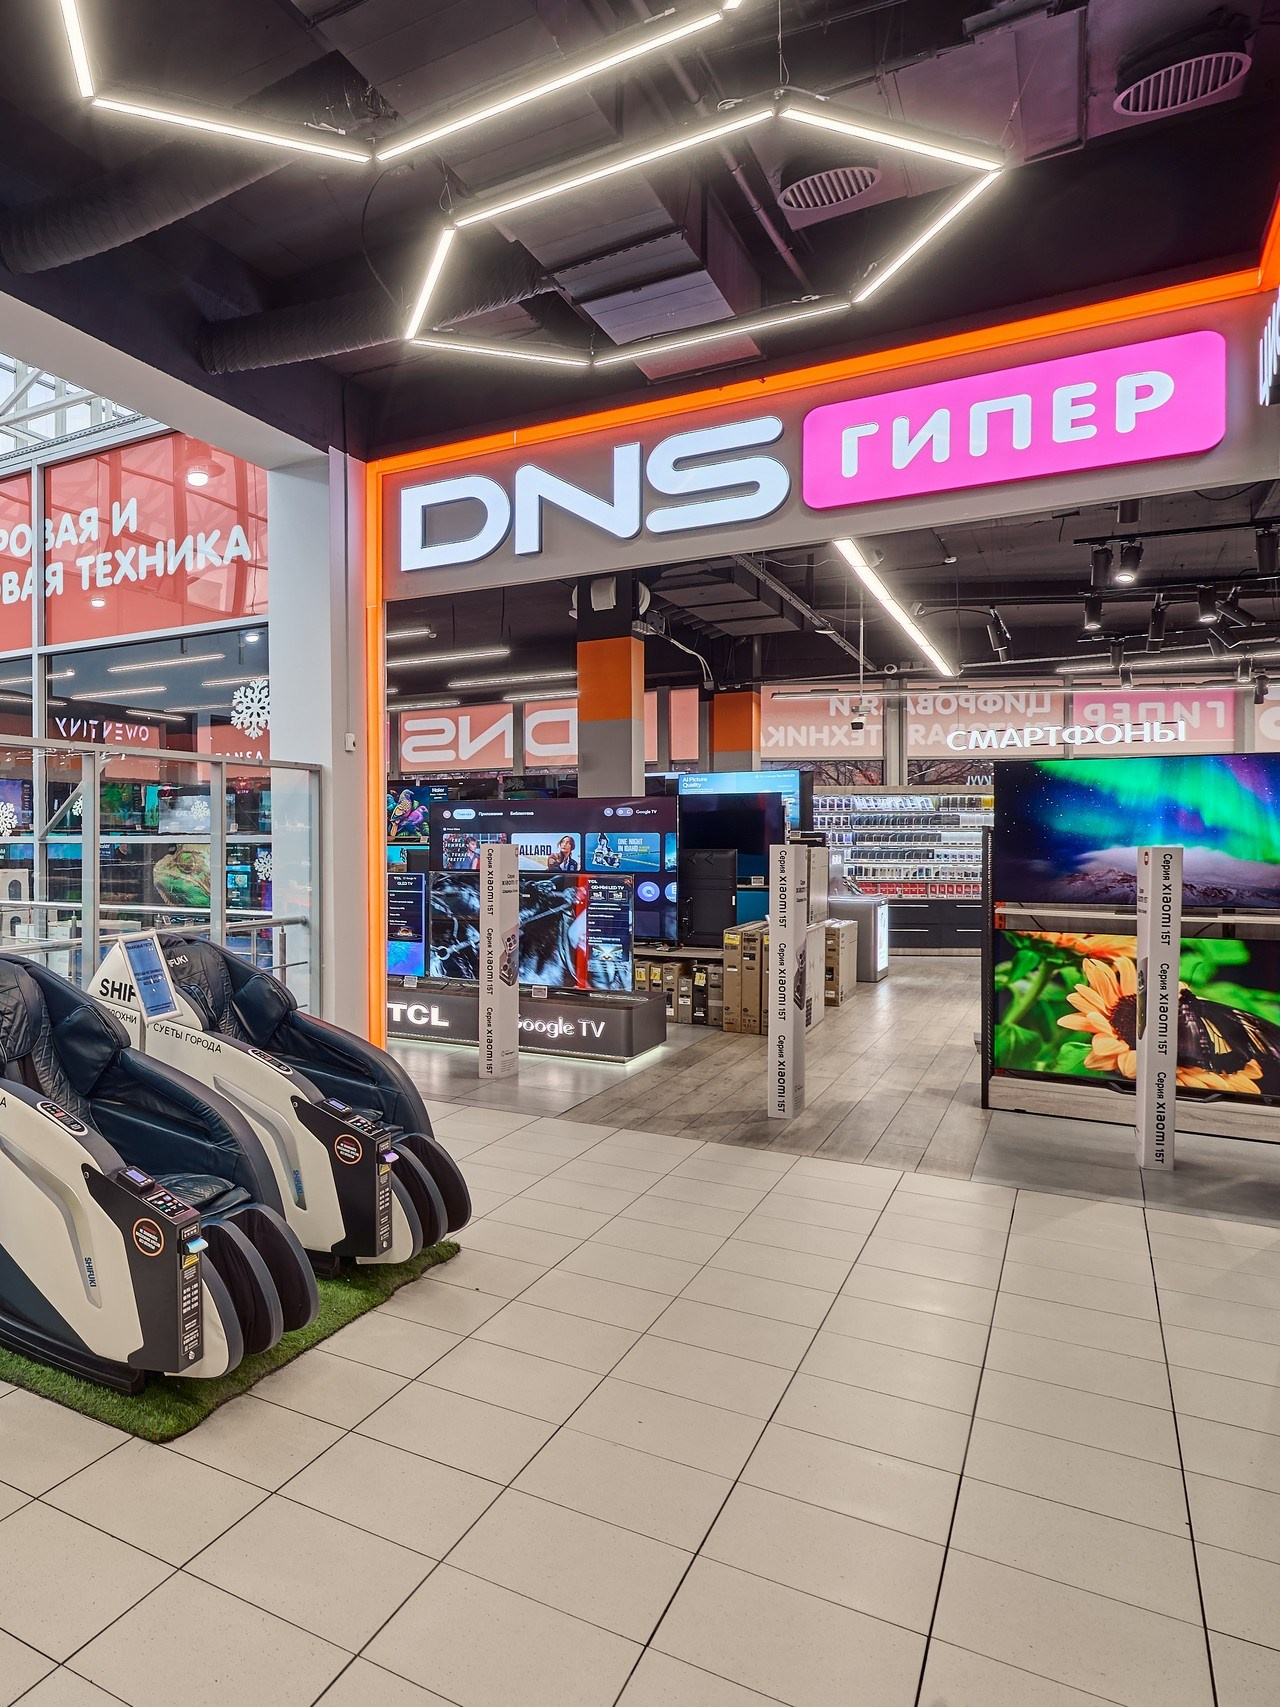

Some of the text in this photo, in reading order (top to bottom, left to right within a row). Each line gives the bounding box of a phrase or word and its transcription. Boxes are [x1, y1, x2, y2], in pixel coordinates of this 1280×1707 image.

[401, 370, 1175, 572] DNS ГИПЕР
[111, 497, 138, 534] И
[75, 525, 251, 591] ТЕХНИКА
[946, 719, 1186, 751] СМАРТФОНЫ
[778, 850, 788, 874] Серия
[1161, 854, 1172, 881] Серия
[486, 928, 494, 948] Серия
[777, 942, 786, 966] Серия
[1160, 962, 1170, 990] Серия
[387, 1001, 450, 1027] TCL
[153, 1022, 222, 1054] СУЕТЫ ГОРОДА
[578, 1020, 606, 1038] TV
[776, 1034, 786, 1058] Серия
[1155, 1072, 1166, 1100] Серия
